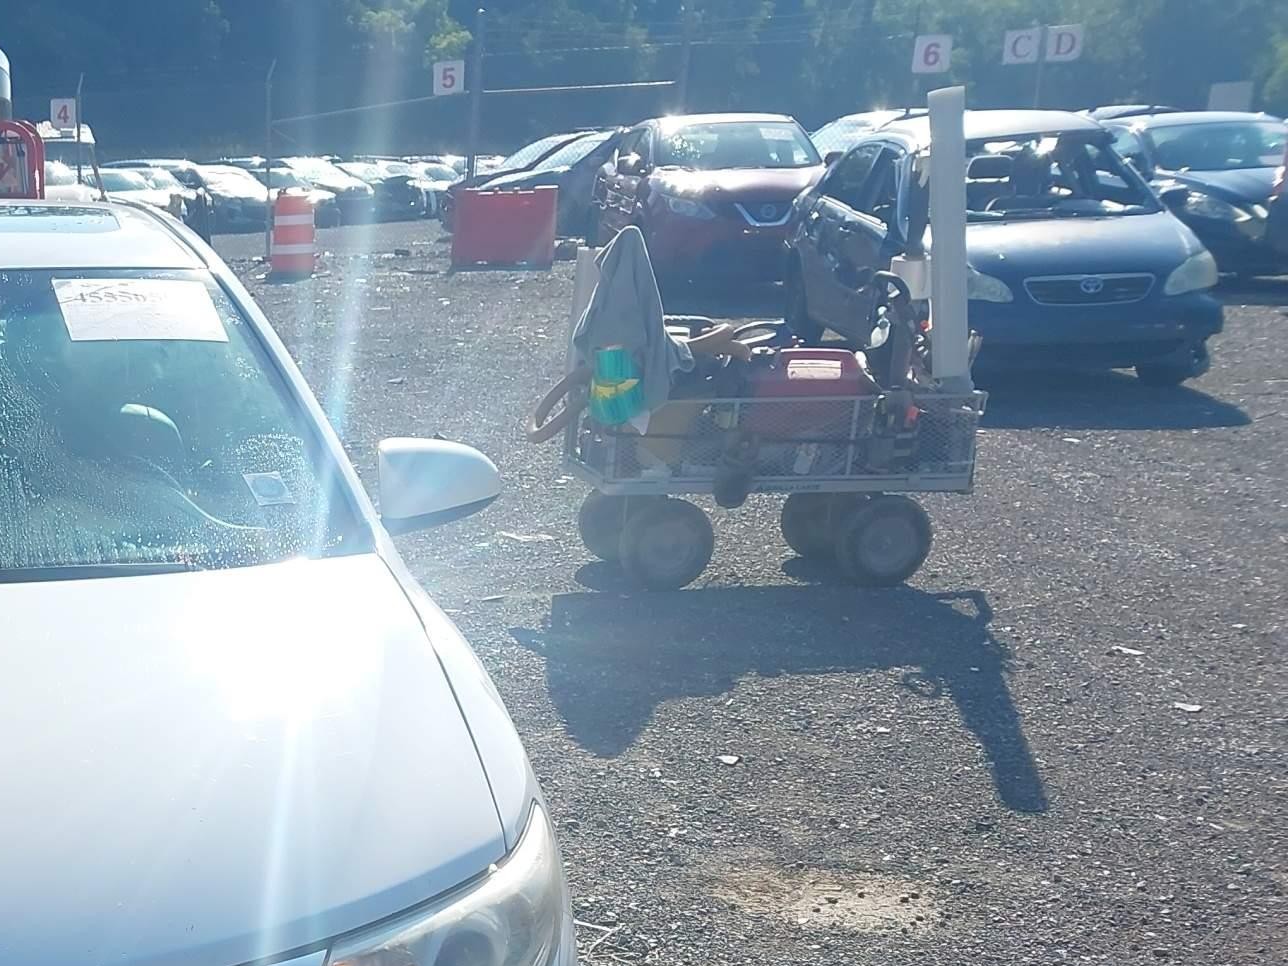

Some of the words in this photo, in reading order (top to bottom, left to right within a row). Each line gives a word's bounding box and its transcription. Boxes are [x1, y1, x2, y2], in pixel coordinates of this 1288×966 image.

[923, 42, 941, 67] 6
[1012, 35, 1032, 59] C
[1053, 31, 1076, 56] D
[442, 67, 455, 89] 5
[57, 104, 69, 124] 4
